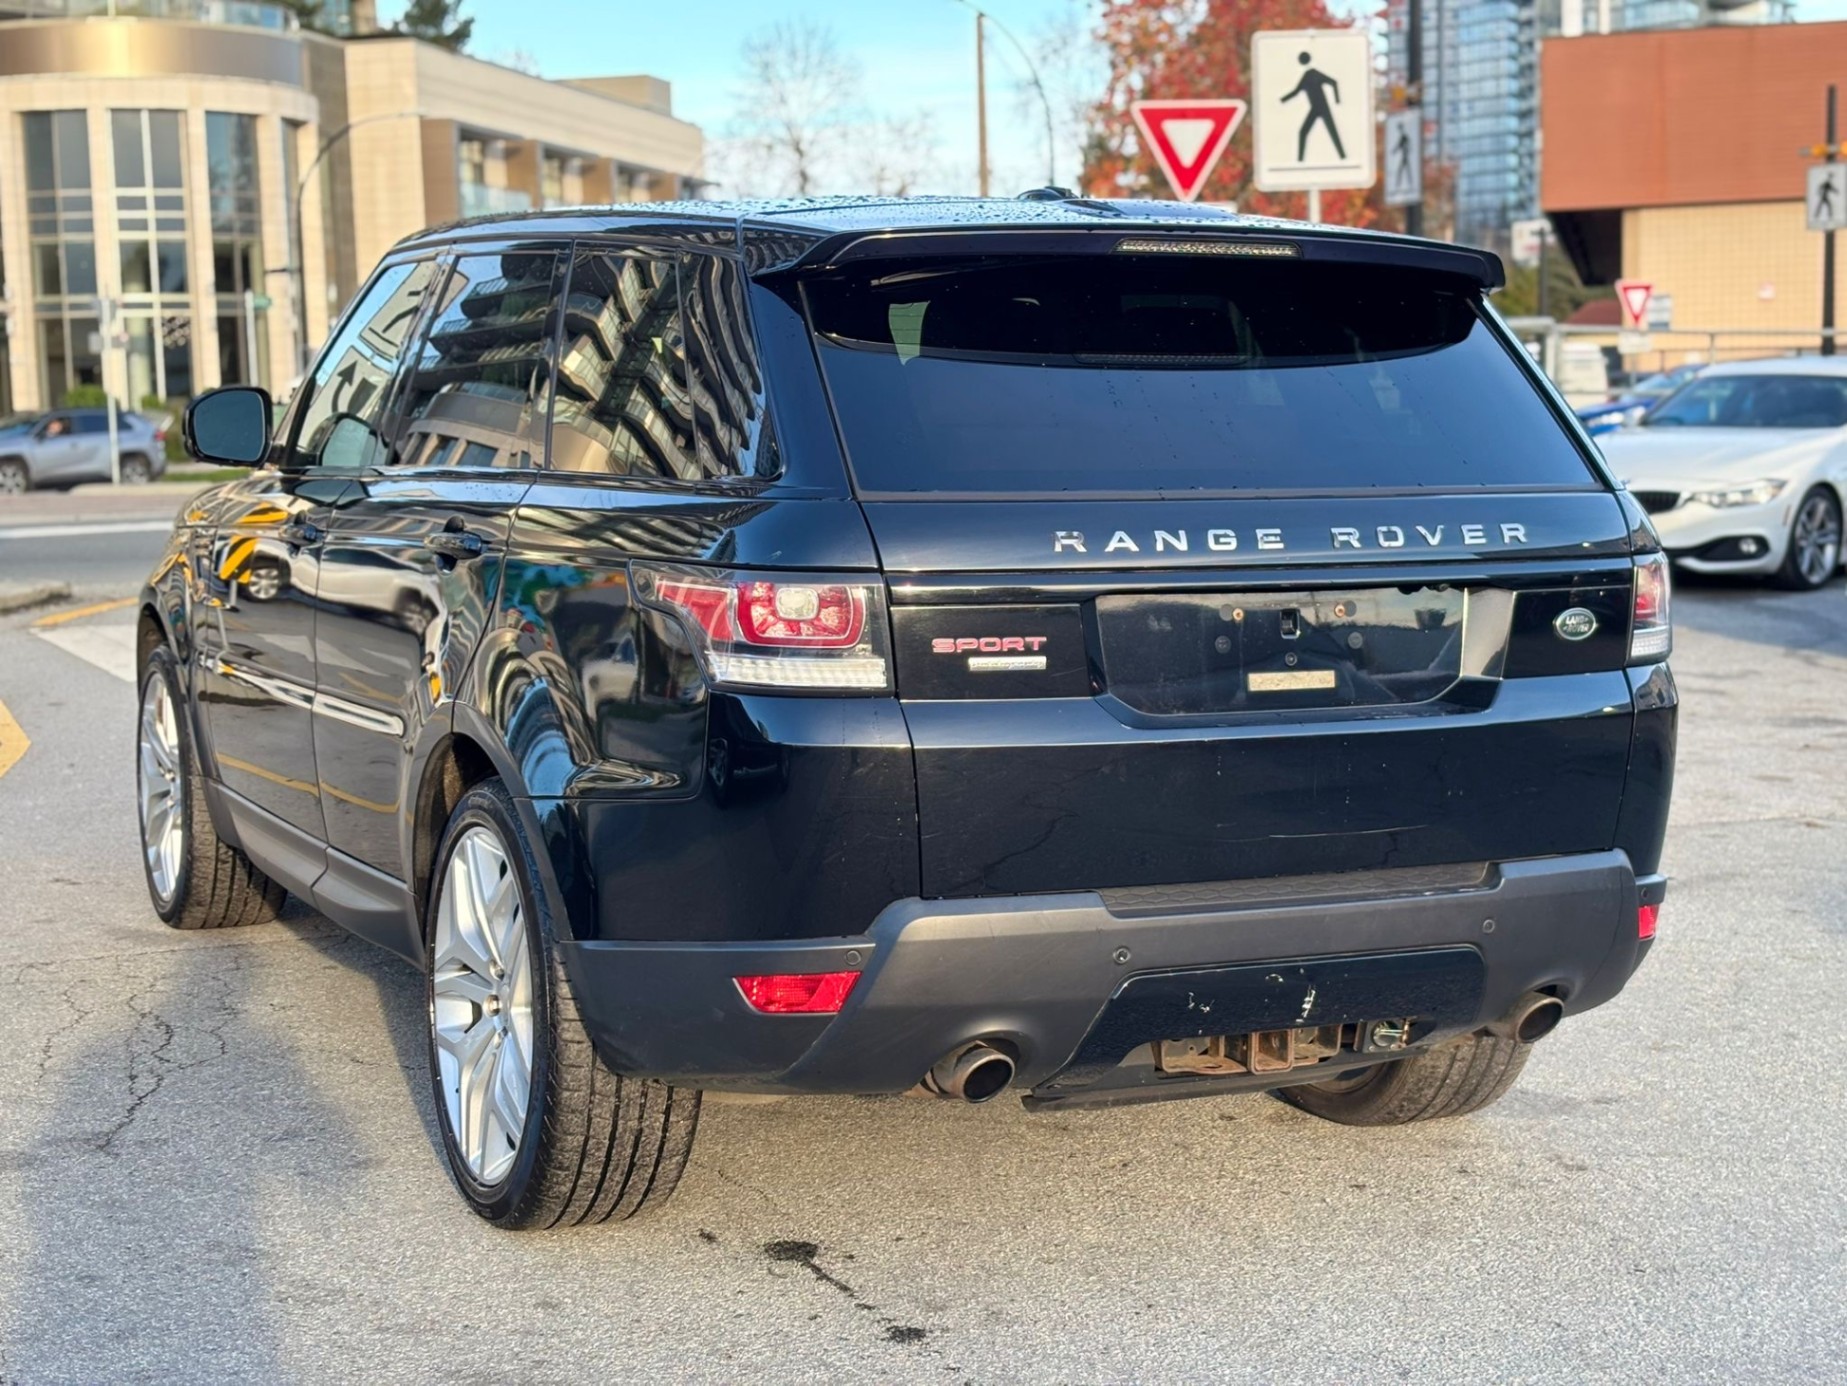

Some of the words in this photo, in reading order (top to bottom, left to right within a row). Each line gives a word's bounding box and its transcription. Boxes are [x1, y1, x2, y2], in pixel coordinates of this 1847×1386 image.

[1053, 528, 1285, 552] RANGE
[1329, 523, 1528, 549] ROVER
[931, 636, 1048, 653] SPORT
